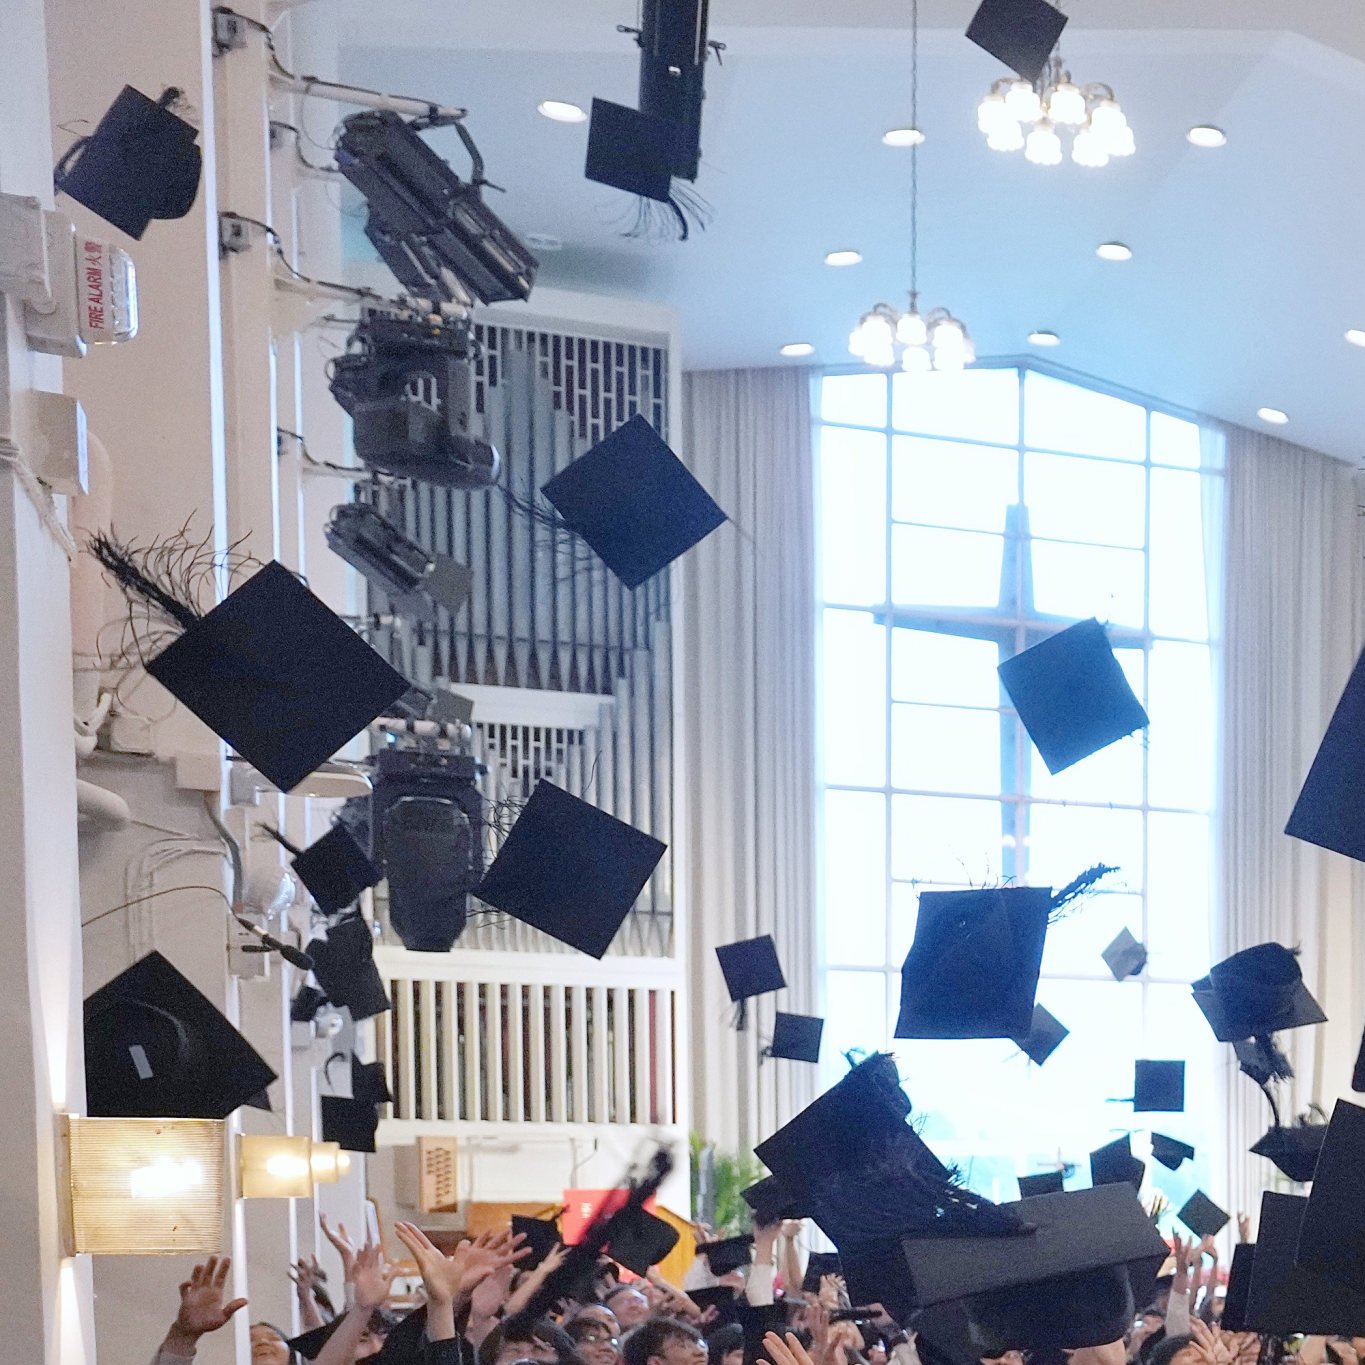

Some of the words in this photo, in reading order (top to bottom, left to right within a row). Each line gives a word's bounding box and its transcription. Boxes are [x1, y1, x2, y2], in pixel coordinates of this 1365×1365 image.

[84, 241, 102, 265] 火警
[85, 267, 104, 305] ALARM
[88, 305, 104, 330] FIRE
